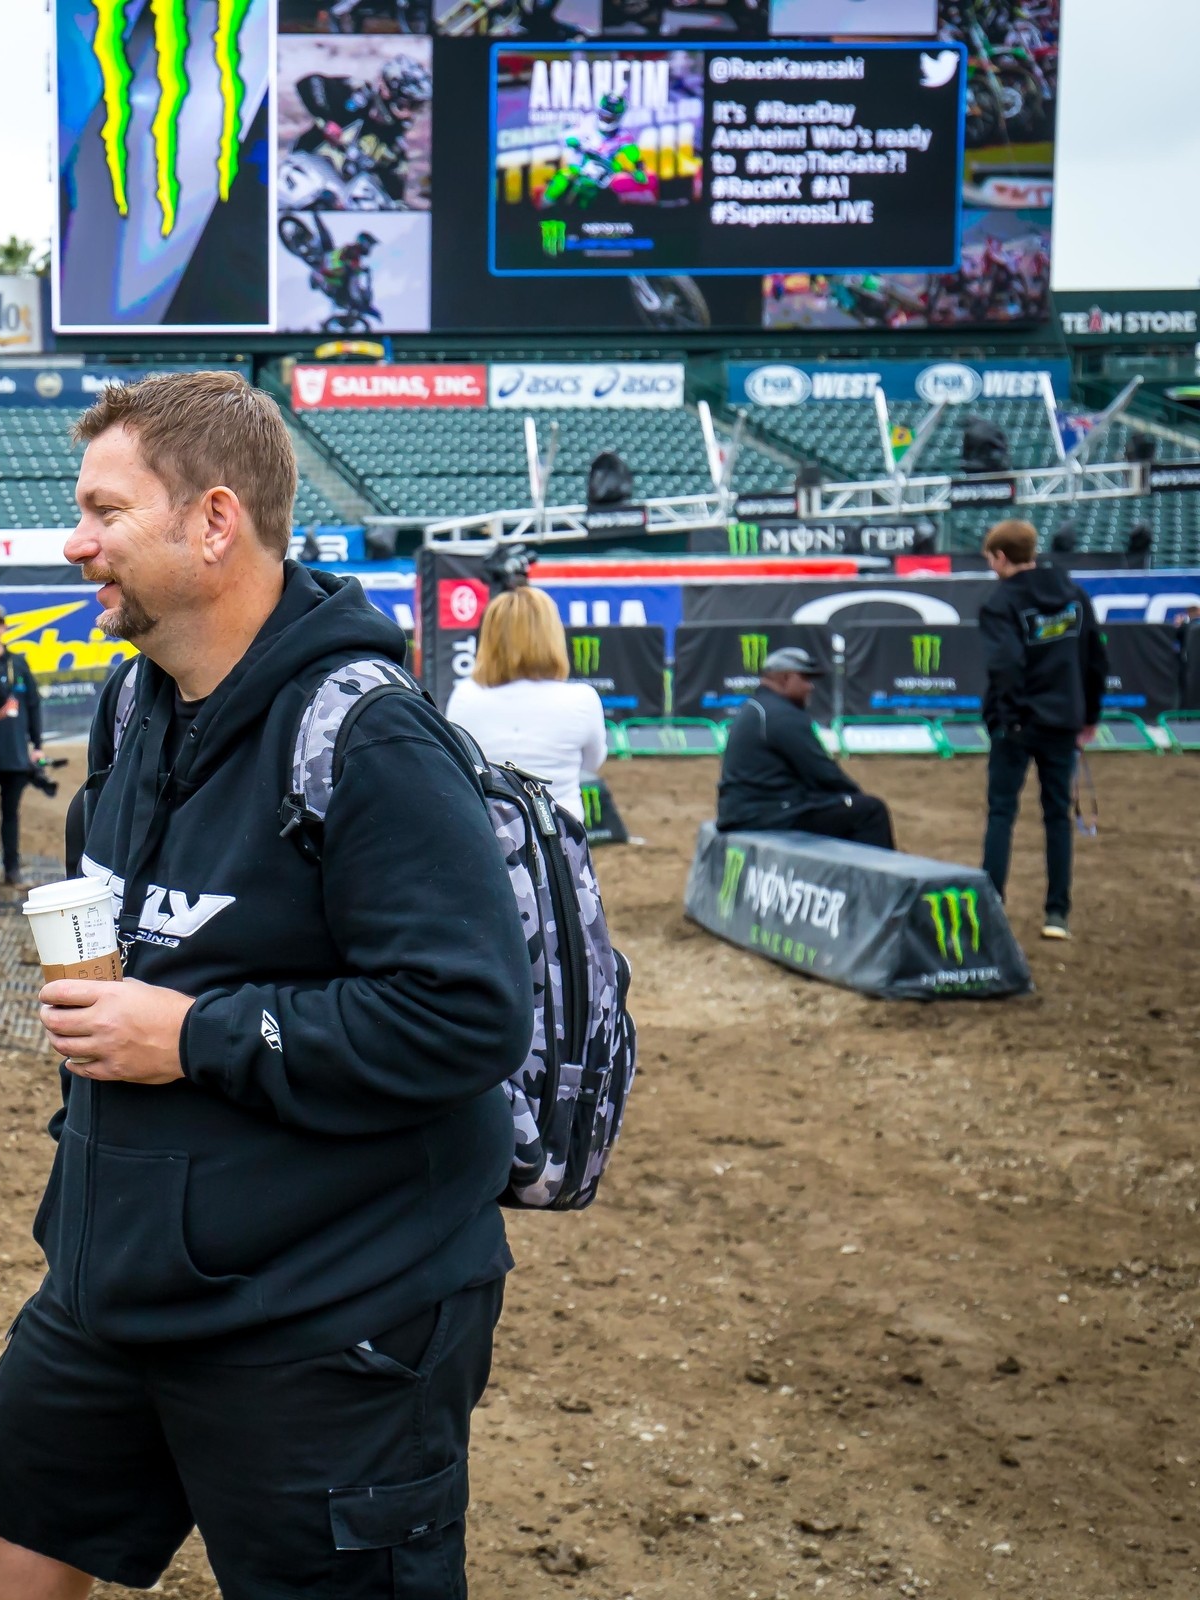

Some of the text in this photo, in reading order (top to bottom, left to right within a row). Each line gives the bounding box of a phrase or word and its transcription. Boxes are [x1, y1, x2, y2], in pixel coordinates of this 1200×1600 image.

[709, 57, 865, 83] @RaceKawasaki
[755, 101, 856, 127] #RaceDay
[810, 125, 873, 149] Who's
[875, 124, 933, 151] ready
[711, 152, 737, 174] to
[711, 200, 874, 227] #SupercrossLIVE
[1061, 305, 1198, 334] TEAM STORE
[331, 375, 481, 399] SALINAS, INC.
[812, 372, 881, 399] WEST
[538, 801, 553, 831] projekt
[744, 863, 847, 940] MONSTER
[72, 914, 84, 963] TARBUCKS
[750, 924, 818, 967] ENERGY
